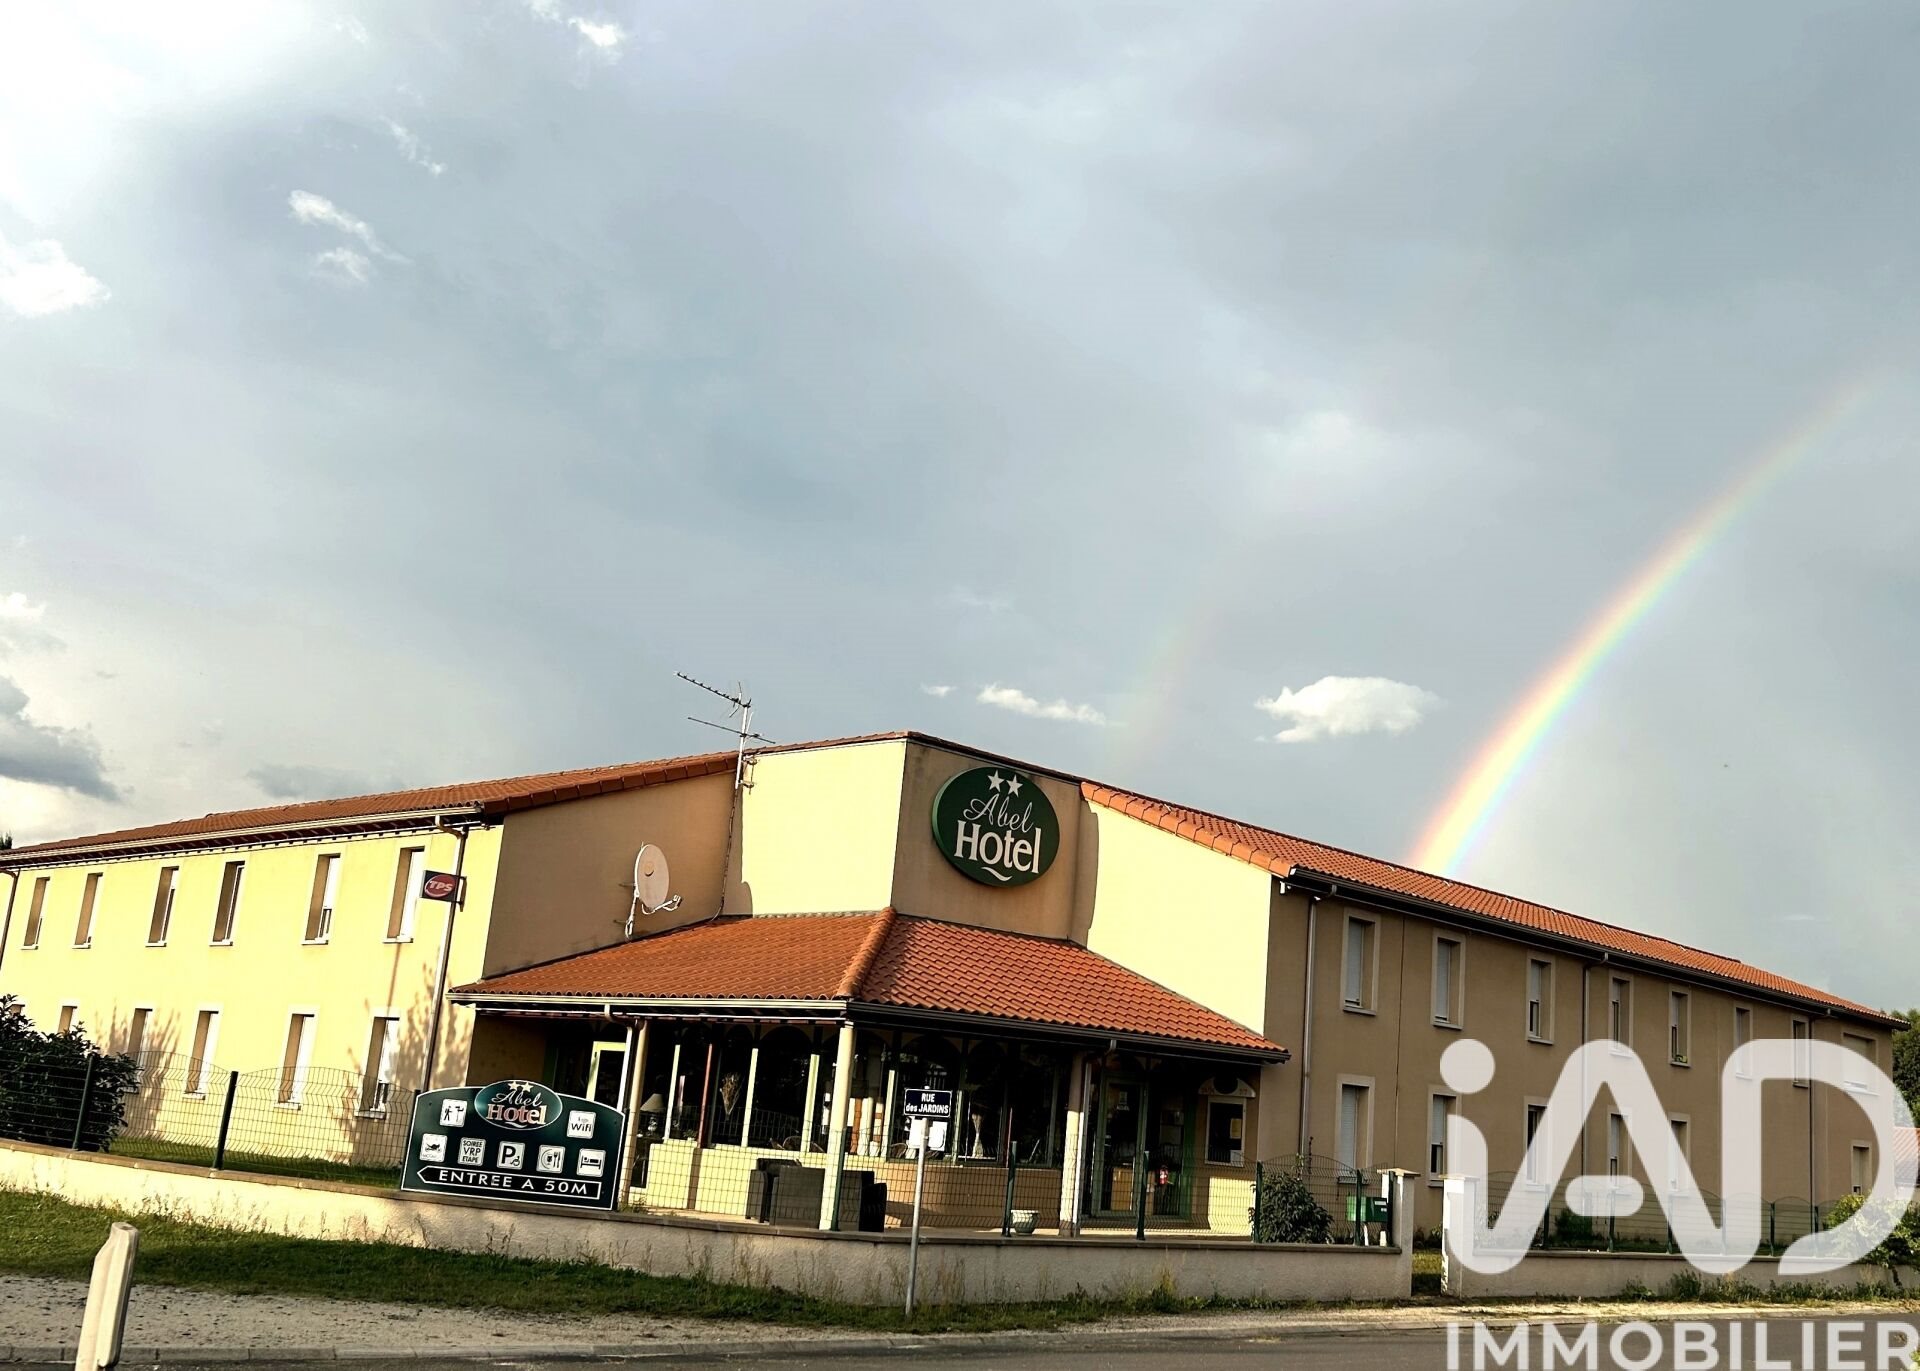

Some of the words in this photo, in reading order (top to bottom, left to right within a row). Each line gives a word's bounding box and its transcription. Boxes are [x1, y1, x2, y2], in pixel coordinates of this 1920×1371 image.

[963, 793, 1034, 833] Abel
[953, 820, 1042, 874] Hotel
[429, 880, 453, 892] TPS
[491, 1090, 543, 1107] Abel
[921, 1093, 936, 1103] RUE
[486, 1103, 547, 1125] Hotel
[906, 1103, 918, 1112] des
[919, 1104, 949, 1114] JARDINS
[571, 1123, 592, 1131] Wifi
[463, 1147, 481, 1156] VRP
[501, 1145, 517, 1164] P
[438, 1170, 513, 1188] ENTREE
[521, 1179, 535, 1190] A
[544, 1181, 588, 1195] 50M
